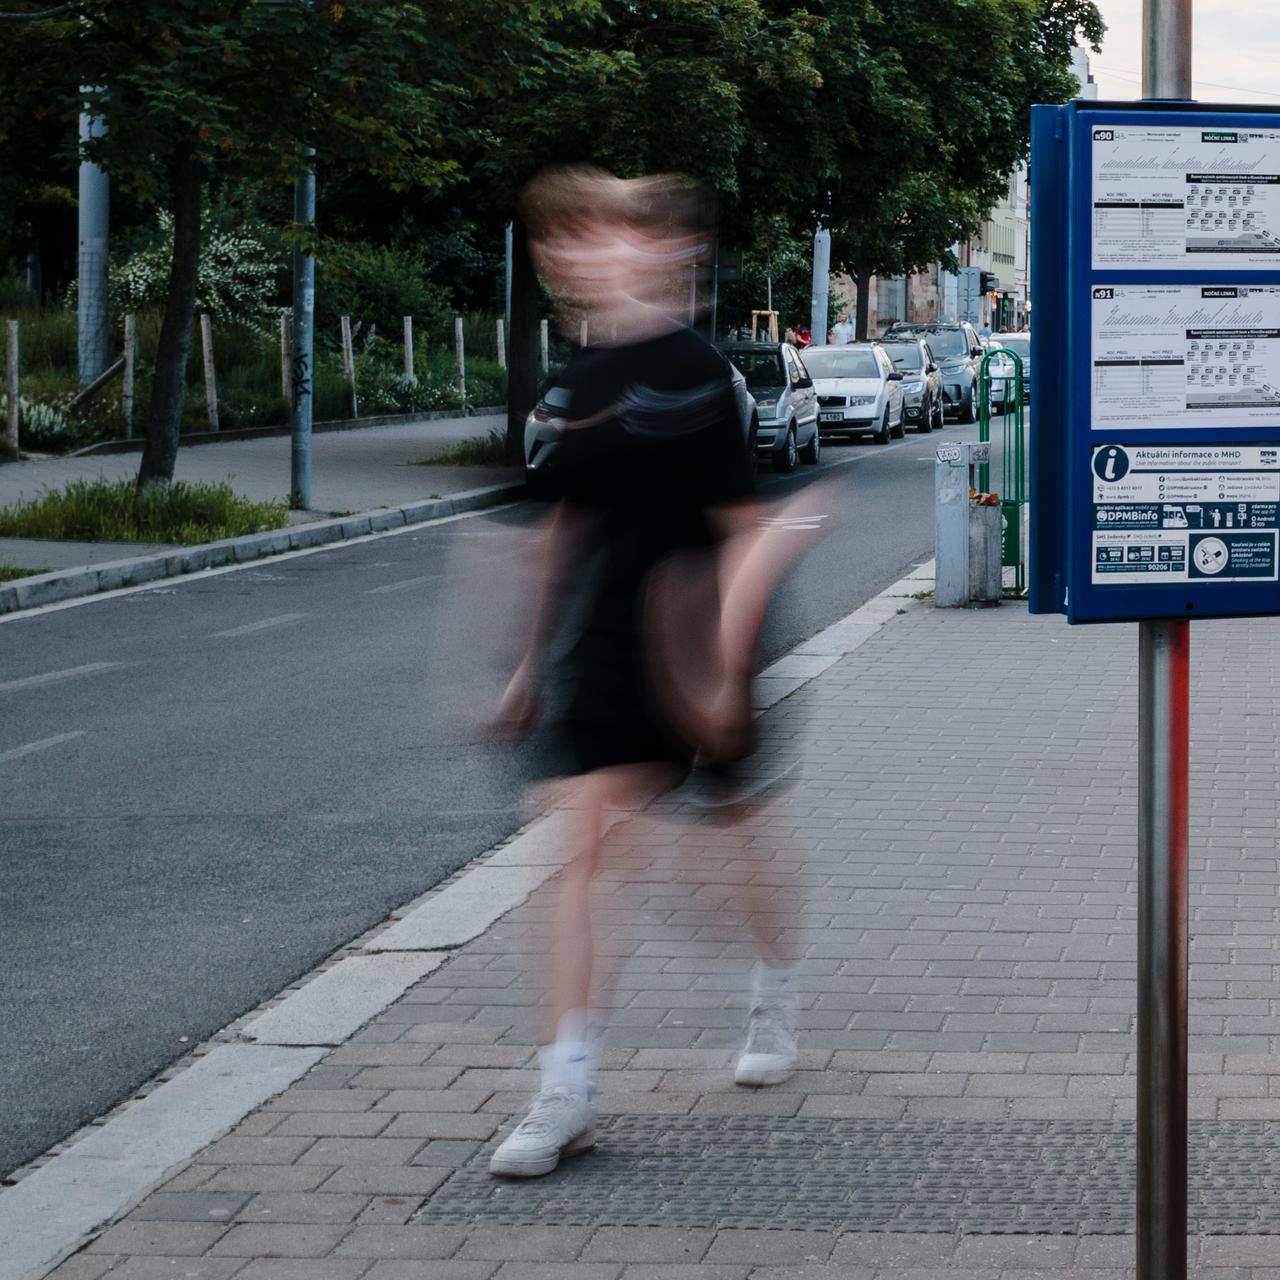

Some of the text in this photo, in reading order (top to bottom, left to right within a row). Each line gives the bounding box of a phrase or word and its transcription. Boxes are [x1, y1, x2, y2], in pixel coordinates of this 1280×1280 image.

[1135, 451, 1170, 459] Aktuální
[1172, 451, 1213, 459] informace
[1221, 451, 1241, 459] MHD
[1107, 511, 1159, 521] DPMBinfo
